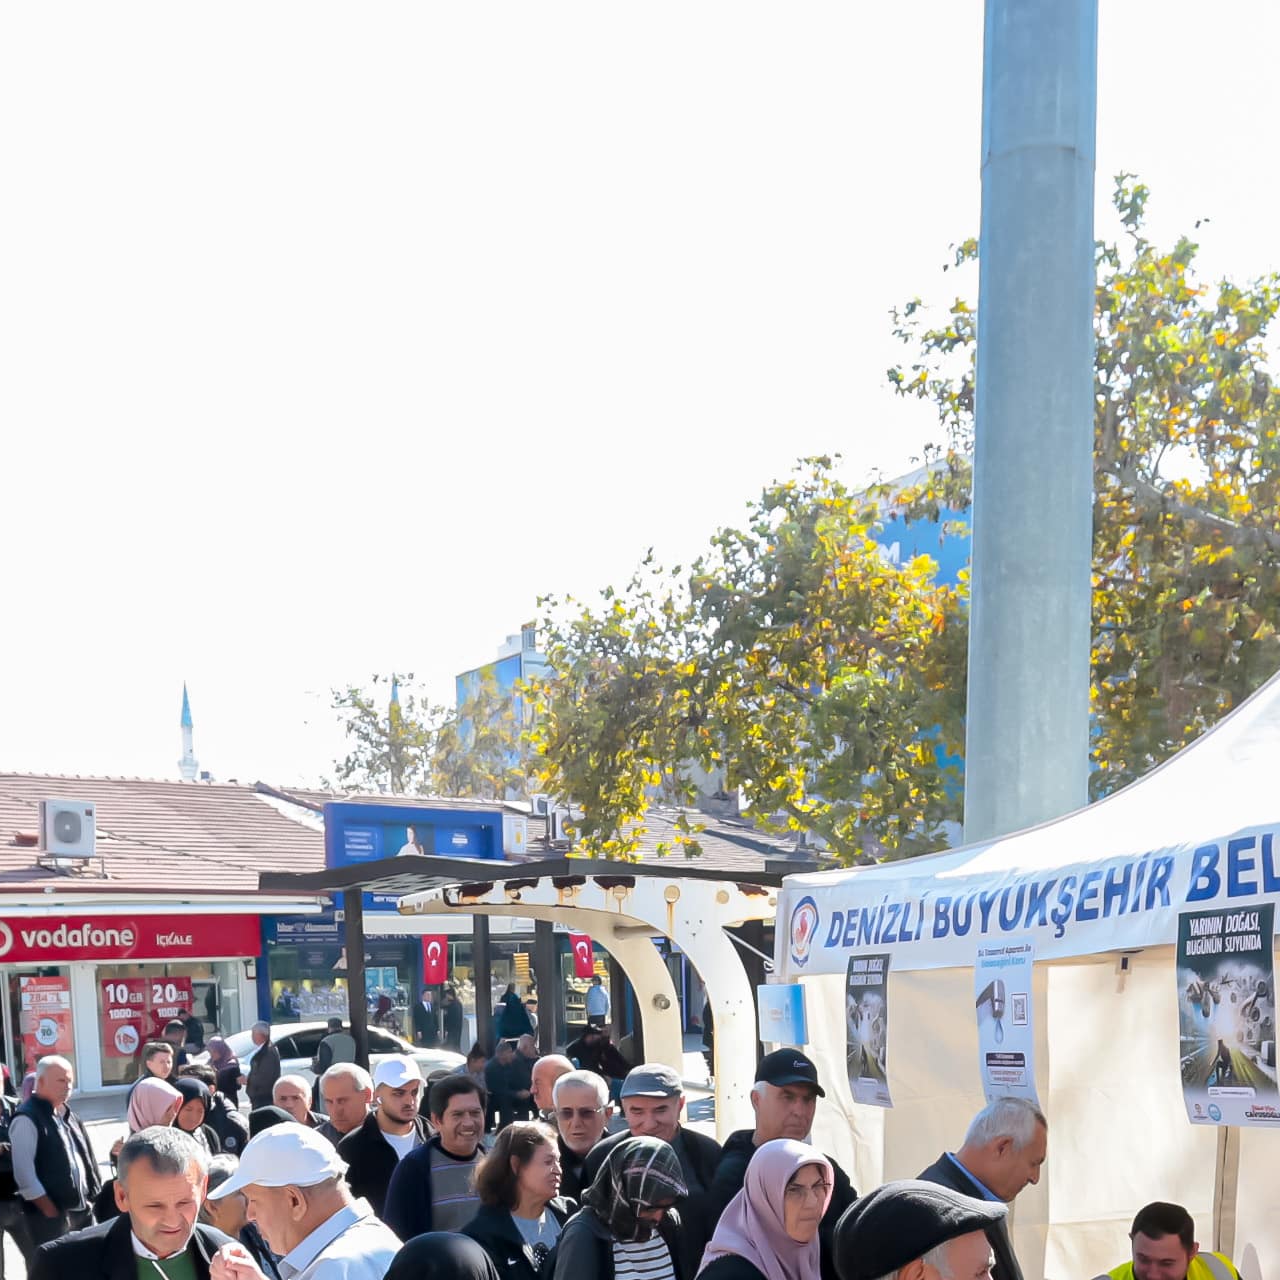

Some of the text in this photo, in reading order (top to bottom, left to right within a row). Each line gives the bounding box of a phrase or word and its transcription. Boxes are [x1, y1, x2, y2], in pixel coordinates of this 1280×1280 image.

[824, 891, 928, 948] DENİZLİ
[932, 851, 1175, 938] BÜYÜKŞEHİR
[1189, 911, 1260, 936] YARININ DOĞASI,
[21, 923, 134, 948] vodafone
[1186, 934, 1261, 956] BUGÜNÜN SUYUNDA
[105, 983, 128, 1003] 10
[152, 983, 176, 1003] 20
